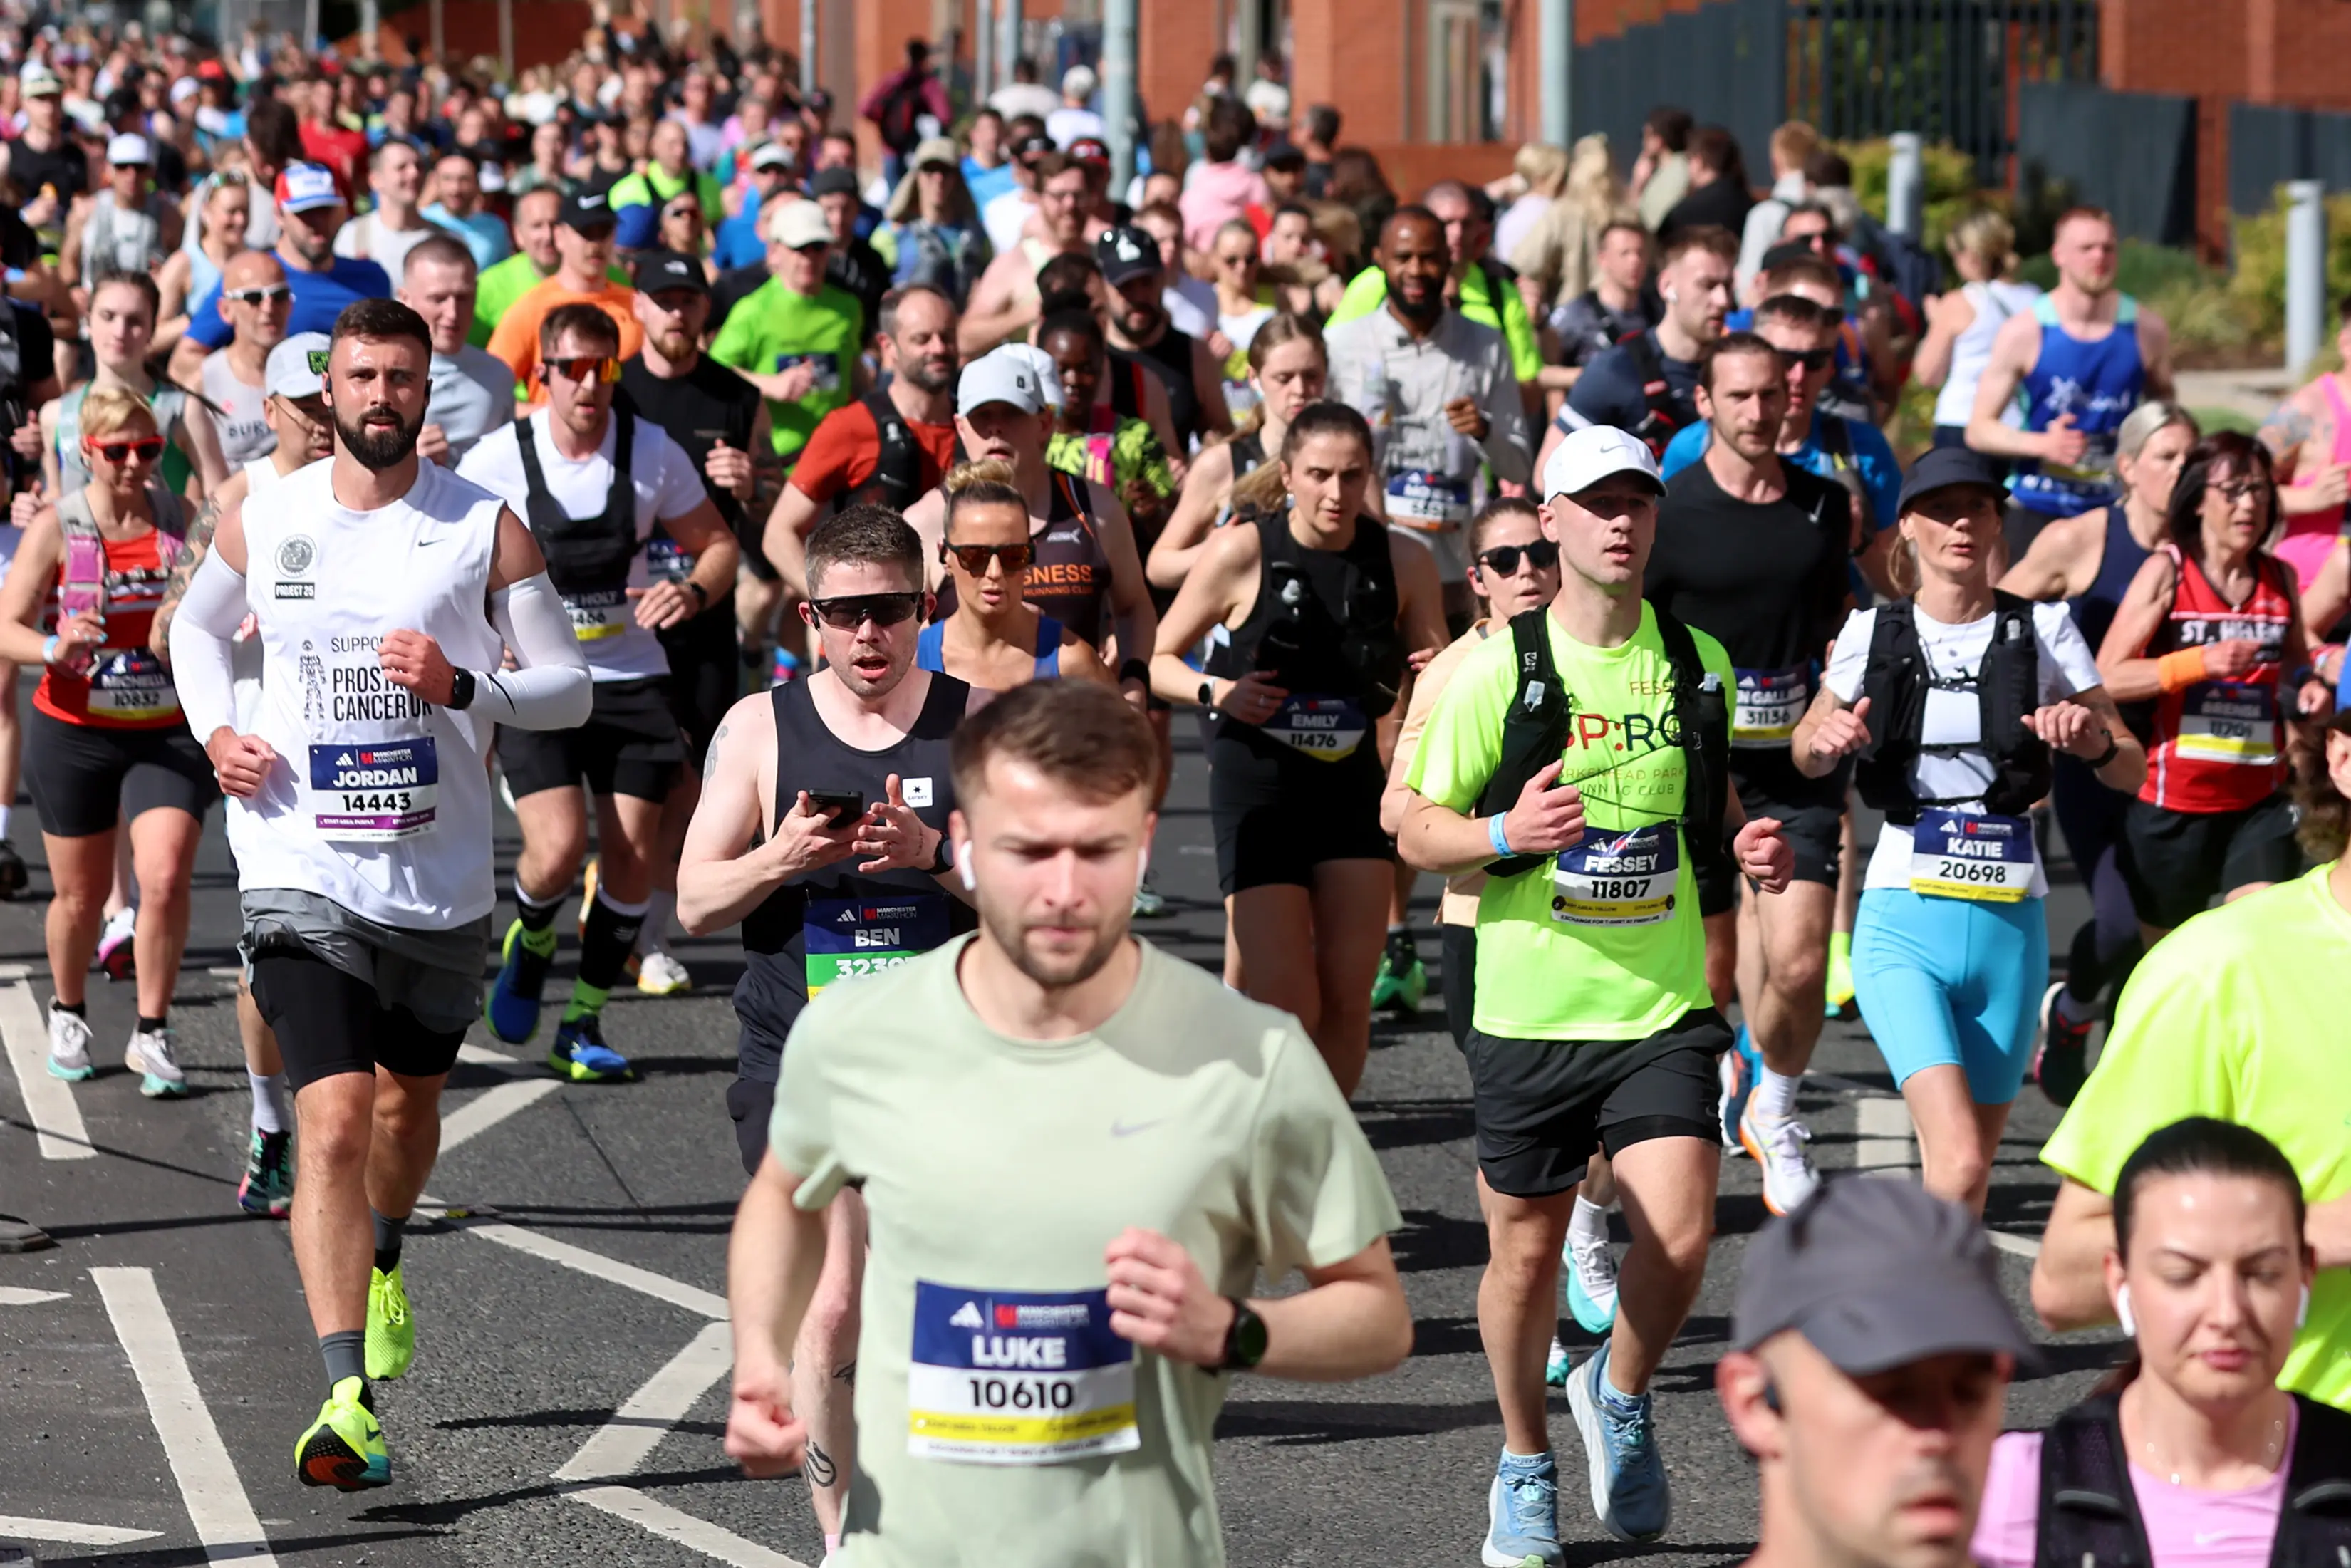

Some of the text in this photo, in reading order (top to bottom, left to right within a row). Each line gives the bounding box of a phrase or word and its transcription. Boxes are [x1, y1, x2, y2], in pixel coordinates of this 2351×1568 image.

[276, 585, 314, 597] PROJECT 25
[1024, 586, 1070, 596] RUNNING
[331, 637, 383, 653] SUPPO
[333, 695, 408, 722] CANCER
[1292, 714, 1339, 727] EMILY
[1290, 732, 1337, 747] 11476
[333, 767, 417, 788] JORDAN
[1639, 784, 1674, 795] CLUB
[342, 792, 412, 812] 14443
[1947, 837, 2003, 858] KATIE
[1584, 853, 1659, 873] FESSEY
[1939, 861, 2006, 883] 20698
[1592, 878, 1651, 899] 11807
[1561, 913, 1592, 924] EXCHANGE
[855, 928, 901, 947] BEN
[972, 1335, 1067, 1368] LUKE
[970, 1379, 1075, 1409] 10610
